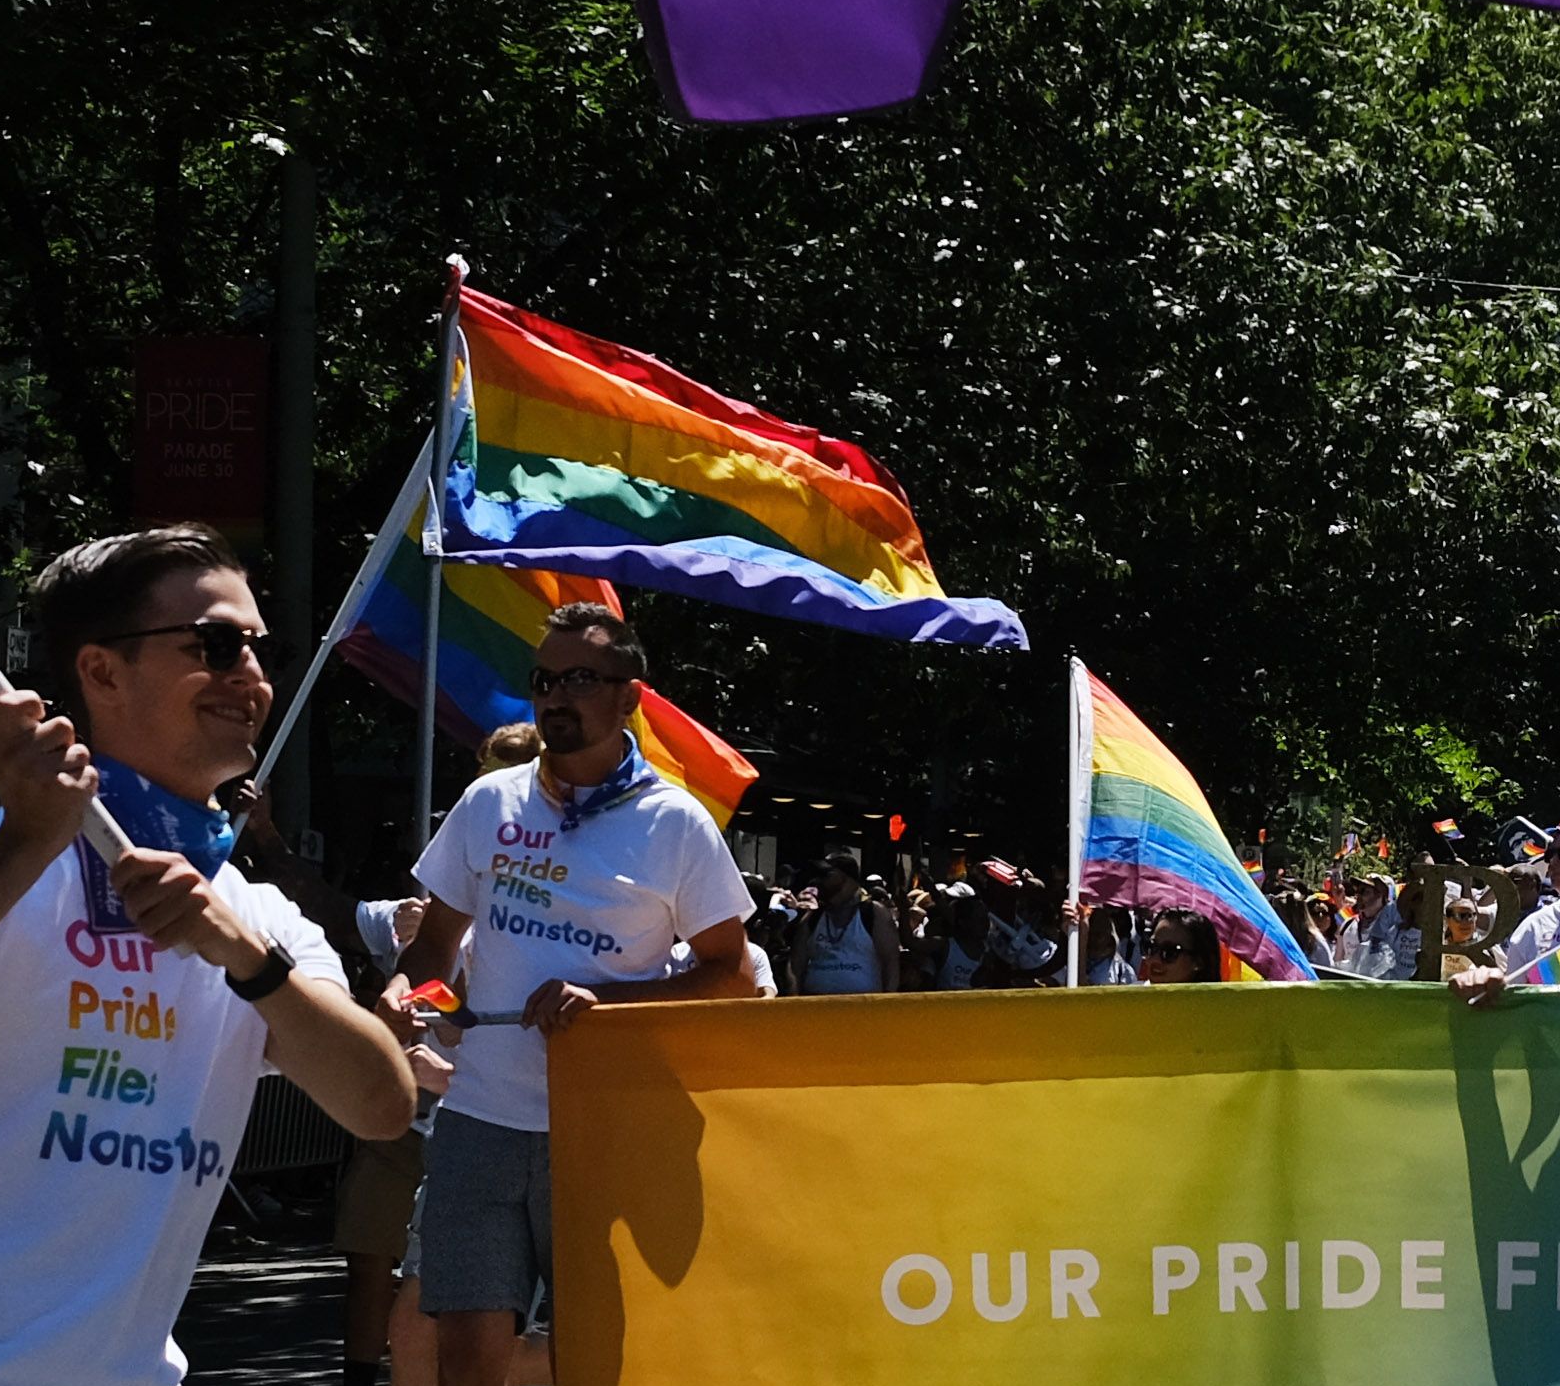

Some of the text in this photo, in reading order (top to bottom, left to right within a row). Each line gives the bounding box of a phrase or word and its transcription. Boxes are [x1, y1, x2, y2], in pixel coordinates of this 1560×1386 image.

[146, 392, 257, 431] PRIDE
[164, 442, 234, 459] PARADE
[163, 462, 234, 478] JUNE 30
[497, 822, 556, 849] Our
[491, 853, 569, 884] Pride
[493, 873, 552, 909] Flies
[65, 919, 159, 974] Our
[489, 903, 623, 956] Nonstop.
[881, 1249, 1102, 1325] OUR
[1151, 1240, 1445, 1315] PRIDE
